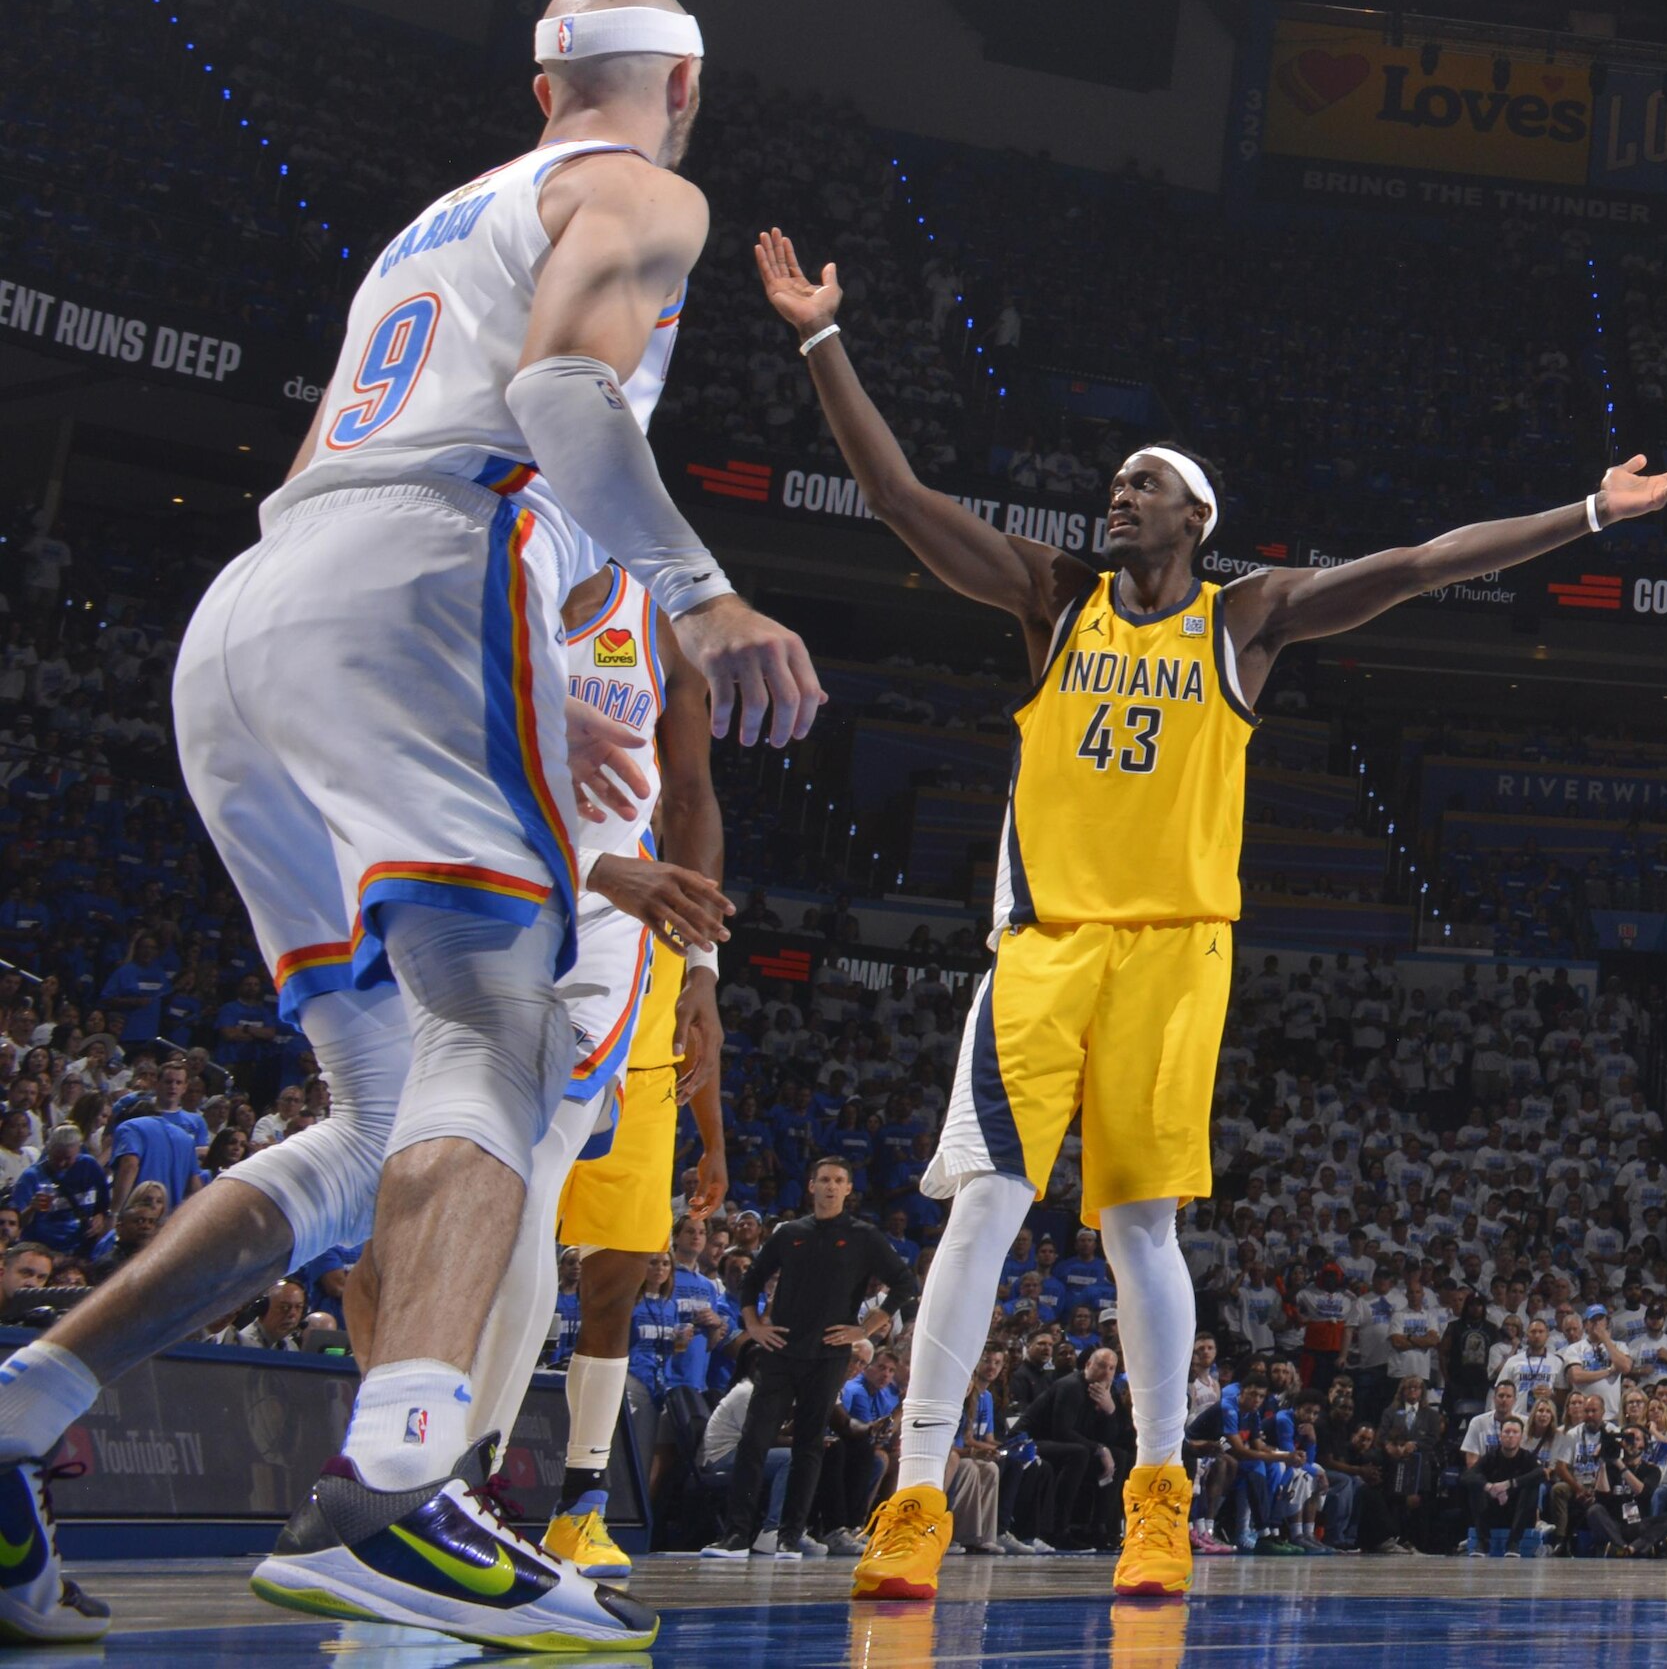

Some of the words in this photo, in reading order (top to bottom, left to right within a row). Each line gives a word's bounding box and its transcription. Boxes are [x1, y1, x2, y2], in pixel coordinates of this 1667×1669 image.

[1303, 169, 1408, 201] BRING
[1420, 181, 1484, 207] THE
[1493, 188, 1651, 224] THUNDER
[379, 192, 497, 278] CARUSO
[54, 300, 148, 363] RUNS
[151, 326, 242, 382] DEEP
[326, 291, 443, 452] 9
[1005, 504, 1088, 551] RUNS
[1453, 585, 1517, 604] Thunder
[1058, 650, 1206, 705] INDIANA
[1076, 701, 1164, 775] 43
[92, 1427, 174, 1475] YouTube
[173, 1430, 206, 1476] TV
